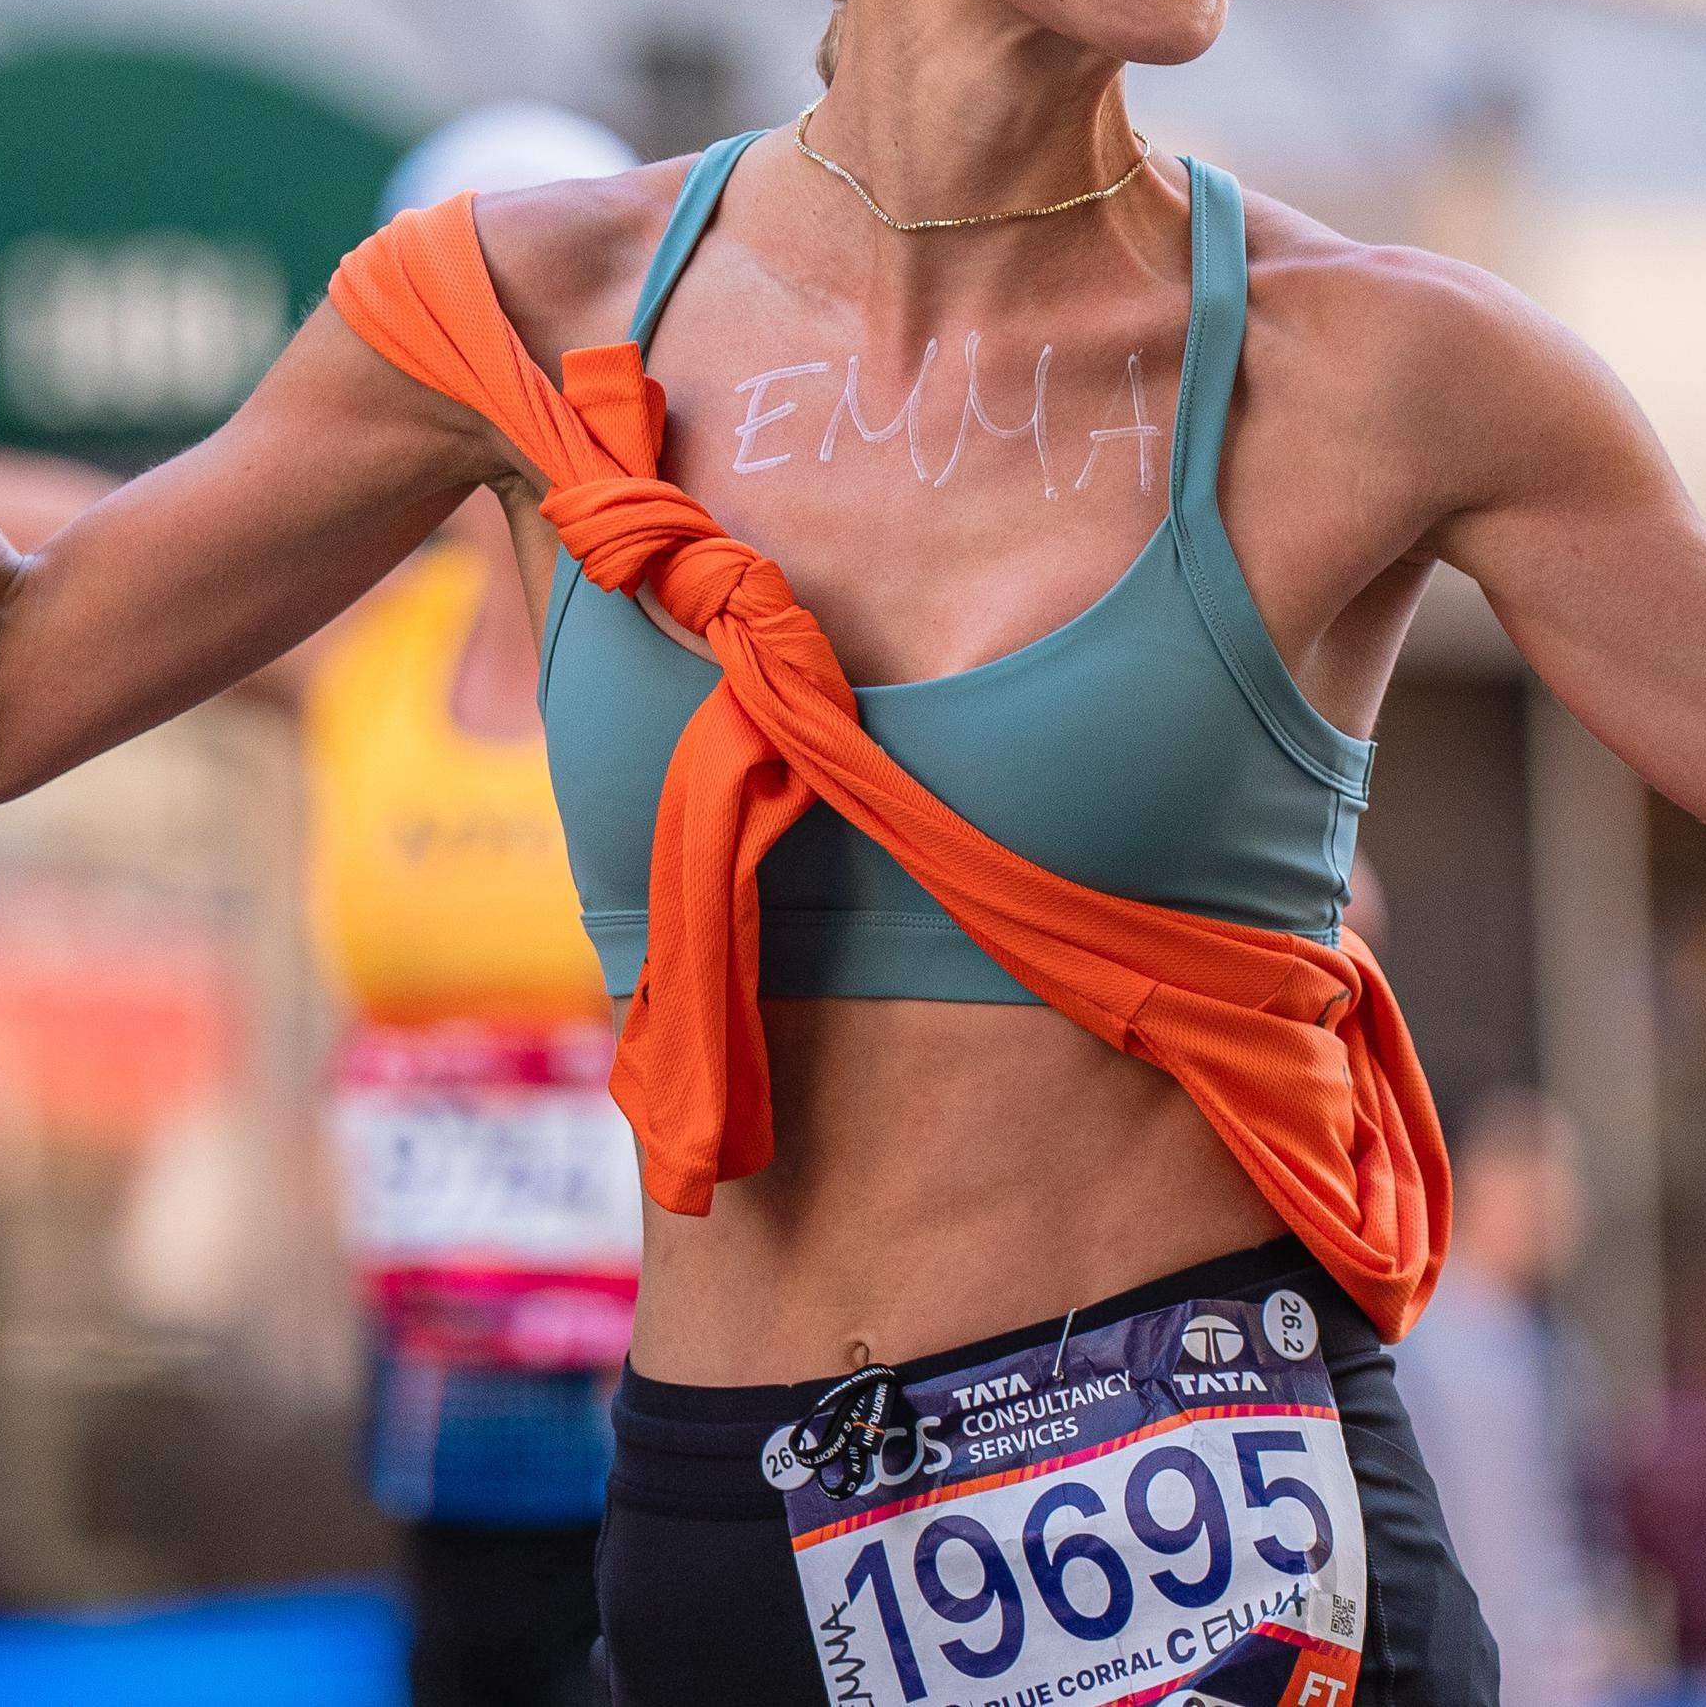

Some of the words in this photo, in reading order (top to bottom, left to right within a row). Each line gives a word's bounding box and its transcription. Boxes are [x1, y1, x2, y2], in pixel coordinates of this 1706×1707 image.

[733, 330, 1160, 499] EMMA
[1279, 1295, 1305, 1354] 26.2
[952, 1373, 1032, 1411] TATA
[962, 1369, 1133, 1438] CONSULTANCY
[1172, 1371, 1268, 1397] TATA
[968, 1416, 1080, 1464] SERVICES
[844, 1430, 1334, 1704] 19695
[820, 1601, 874, 1707] MMA
[1057, 1646, 1162, 1698] CORRAL
[1166, 1628, 1197, 1664] C
[1297, 1671, 1347, 1707] FT
